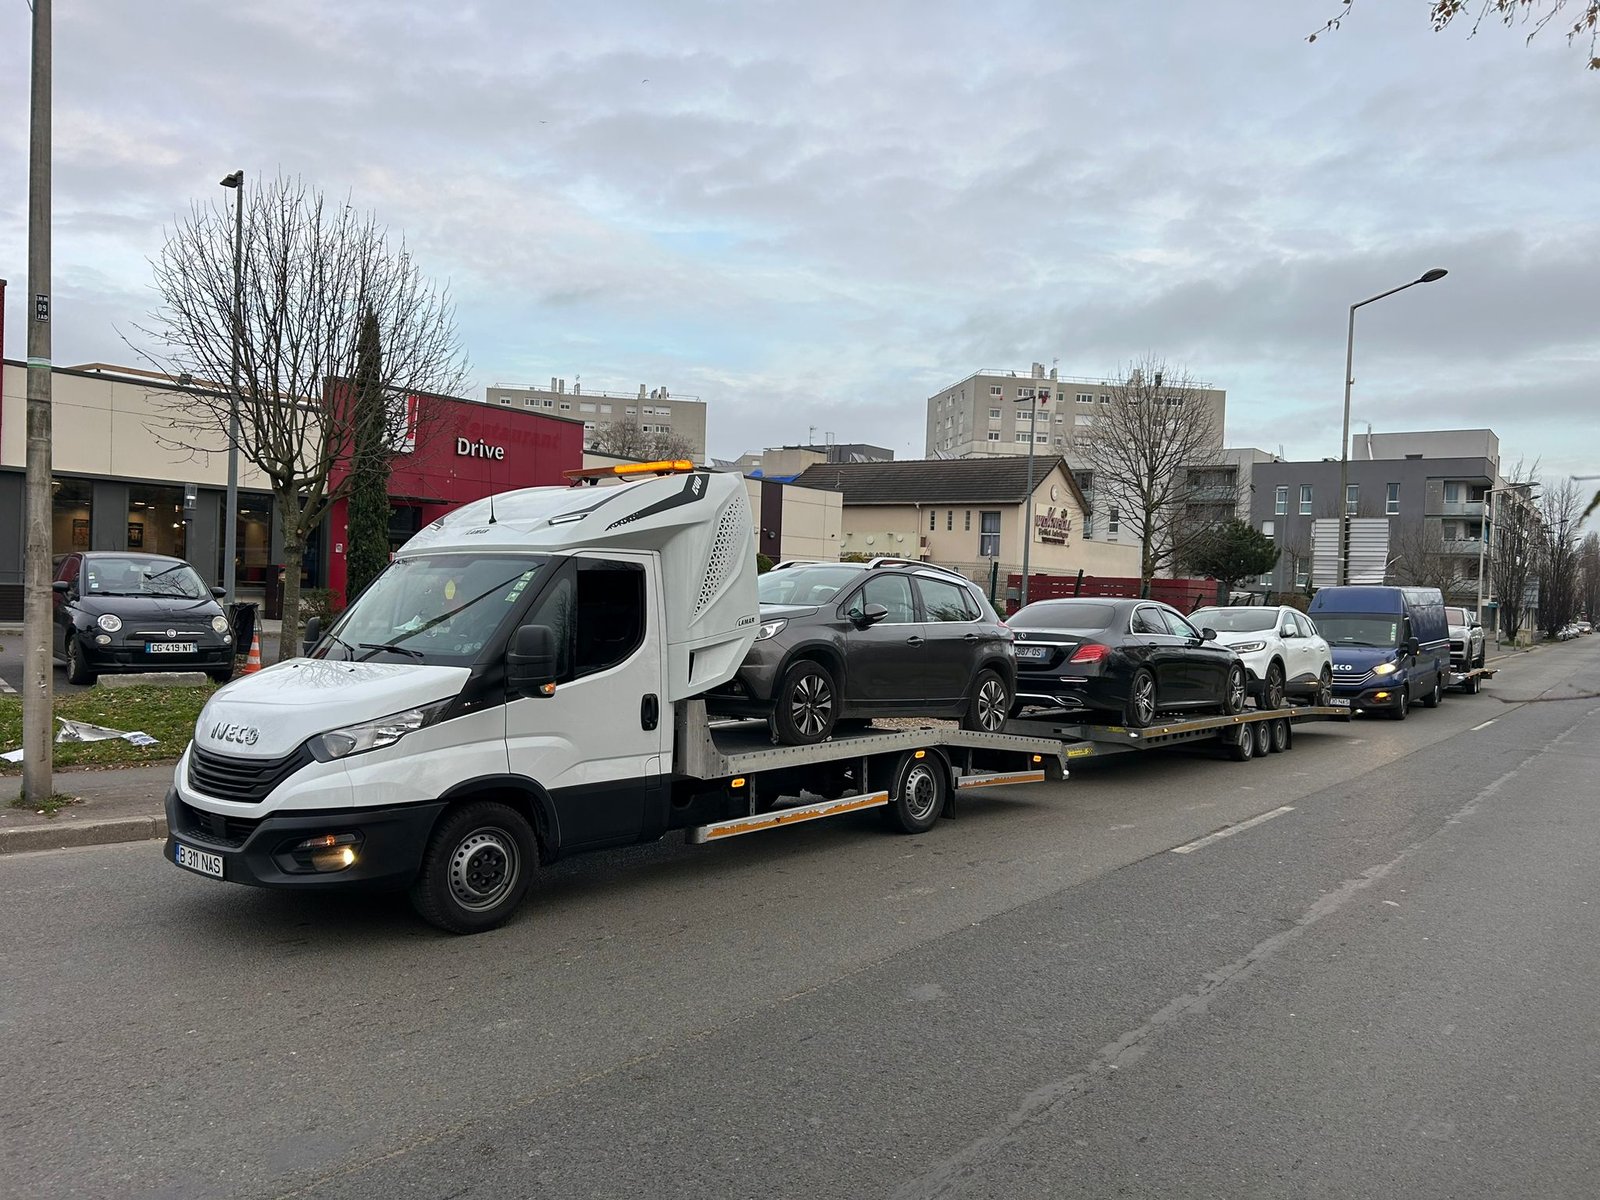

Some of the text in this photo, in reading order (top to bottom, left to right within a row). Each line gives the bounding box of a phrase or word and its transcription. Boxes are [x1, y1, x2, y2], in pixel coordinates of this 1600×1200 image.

[457, 437, 504, 460] Drive
[738, 617, 755, 626] LAMAR
[210, 722, 260, 746] IVECO
[180, 847, 222, 874] B 311 NAS
